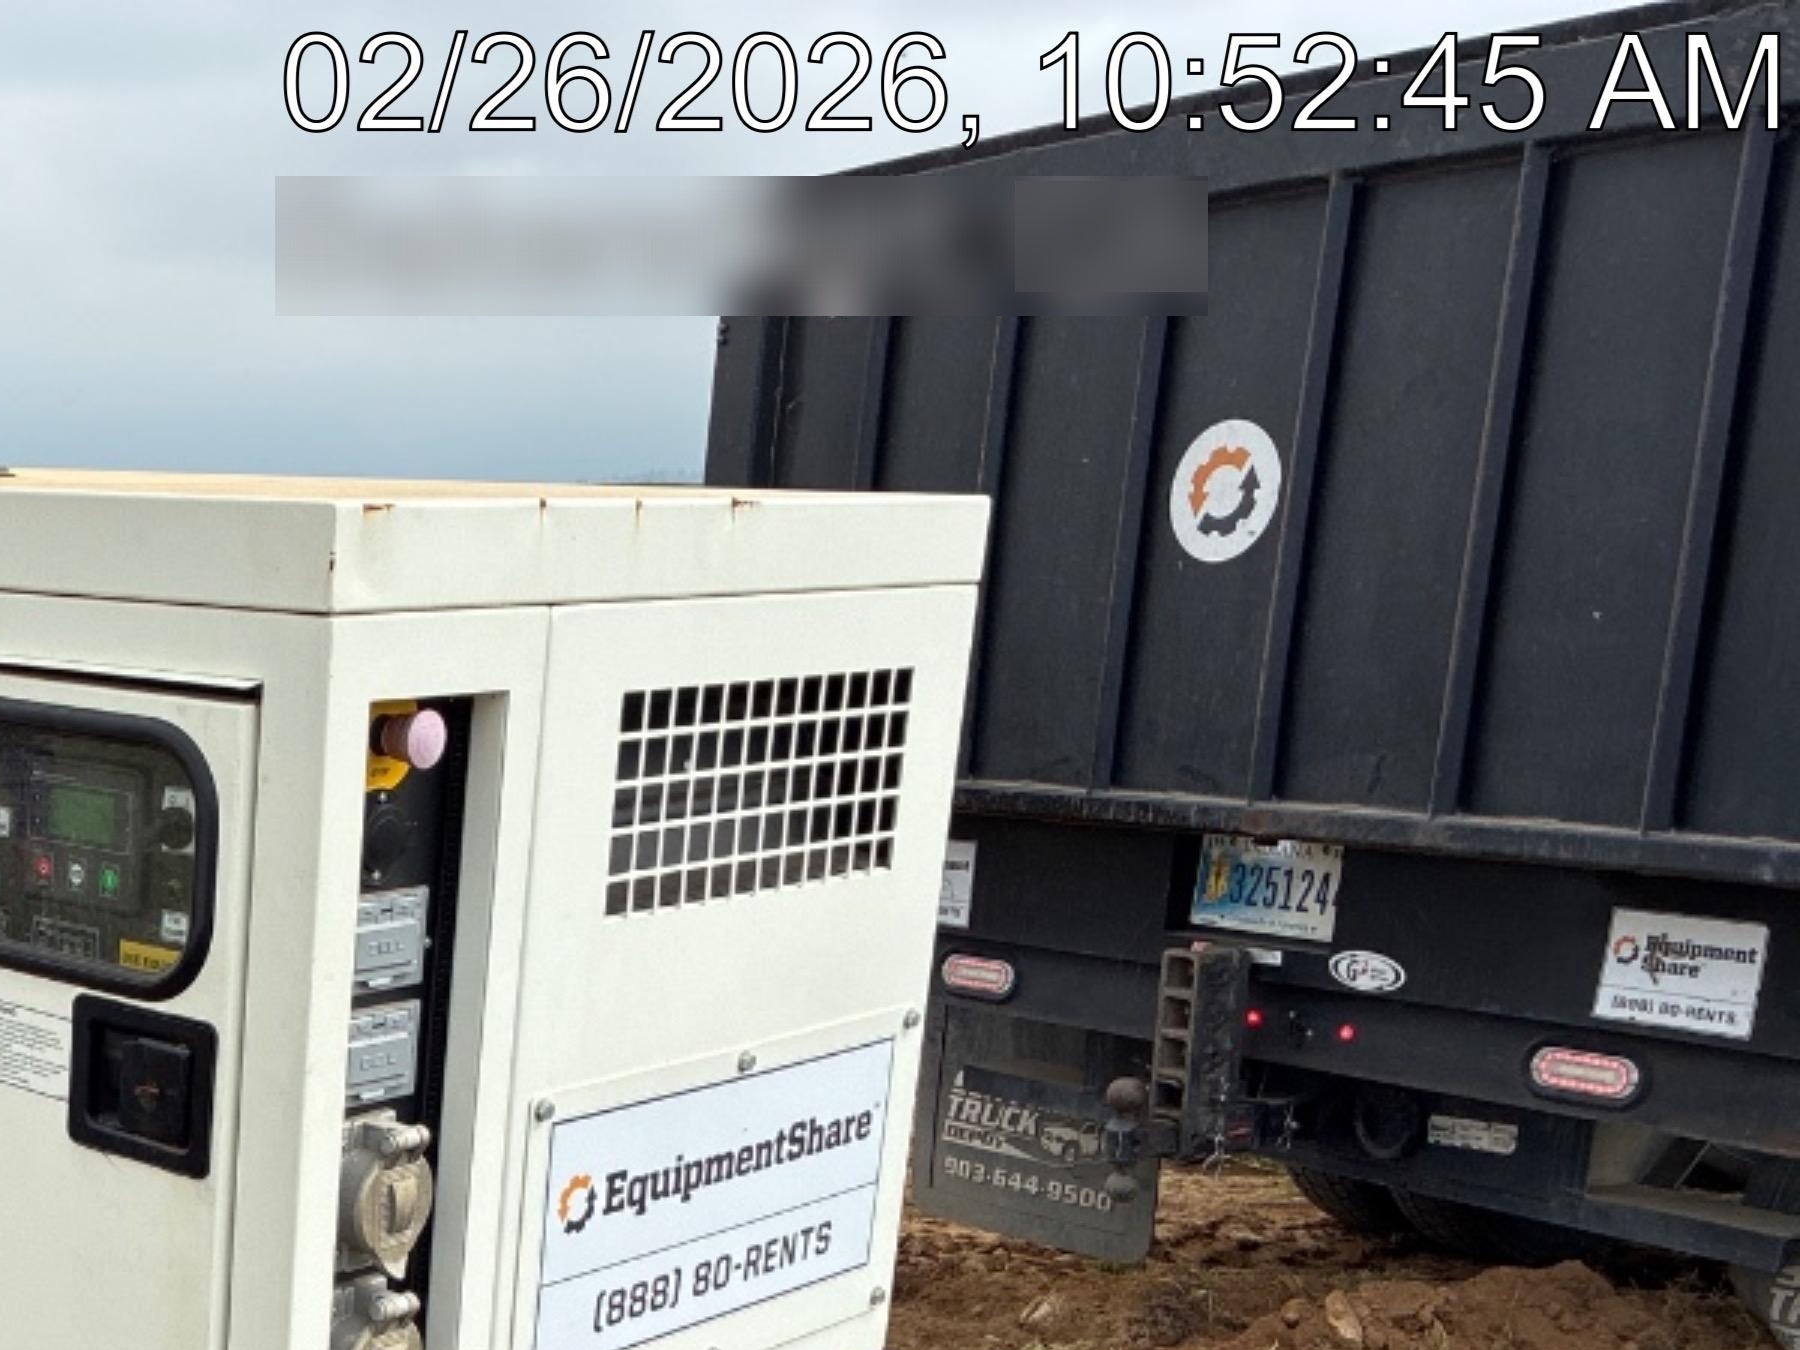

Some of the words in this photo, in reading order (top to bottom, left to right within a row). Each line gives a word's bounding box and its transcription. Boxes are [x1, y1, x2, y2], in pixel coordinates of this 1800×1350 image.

[1230, 863, 1332, 917] 325124
[1645, 932, 1759, 964] Equipment
[948, 1094, 1039, 1136] TRUCK
[602, 1108, 872, 1217] EquipmentShare
[593, 1268, 682, 1333] (888)
[691, 1220, 833, 1298] 80-RENTS
